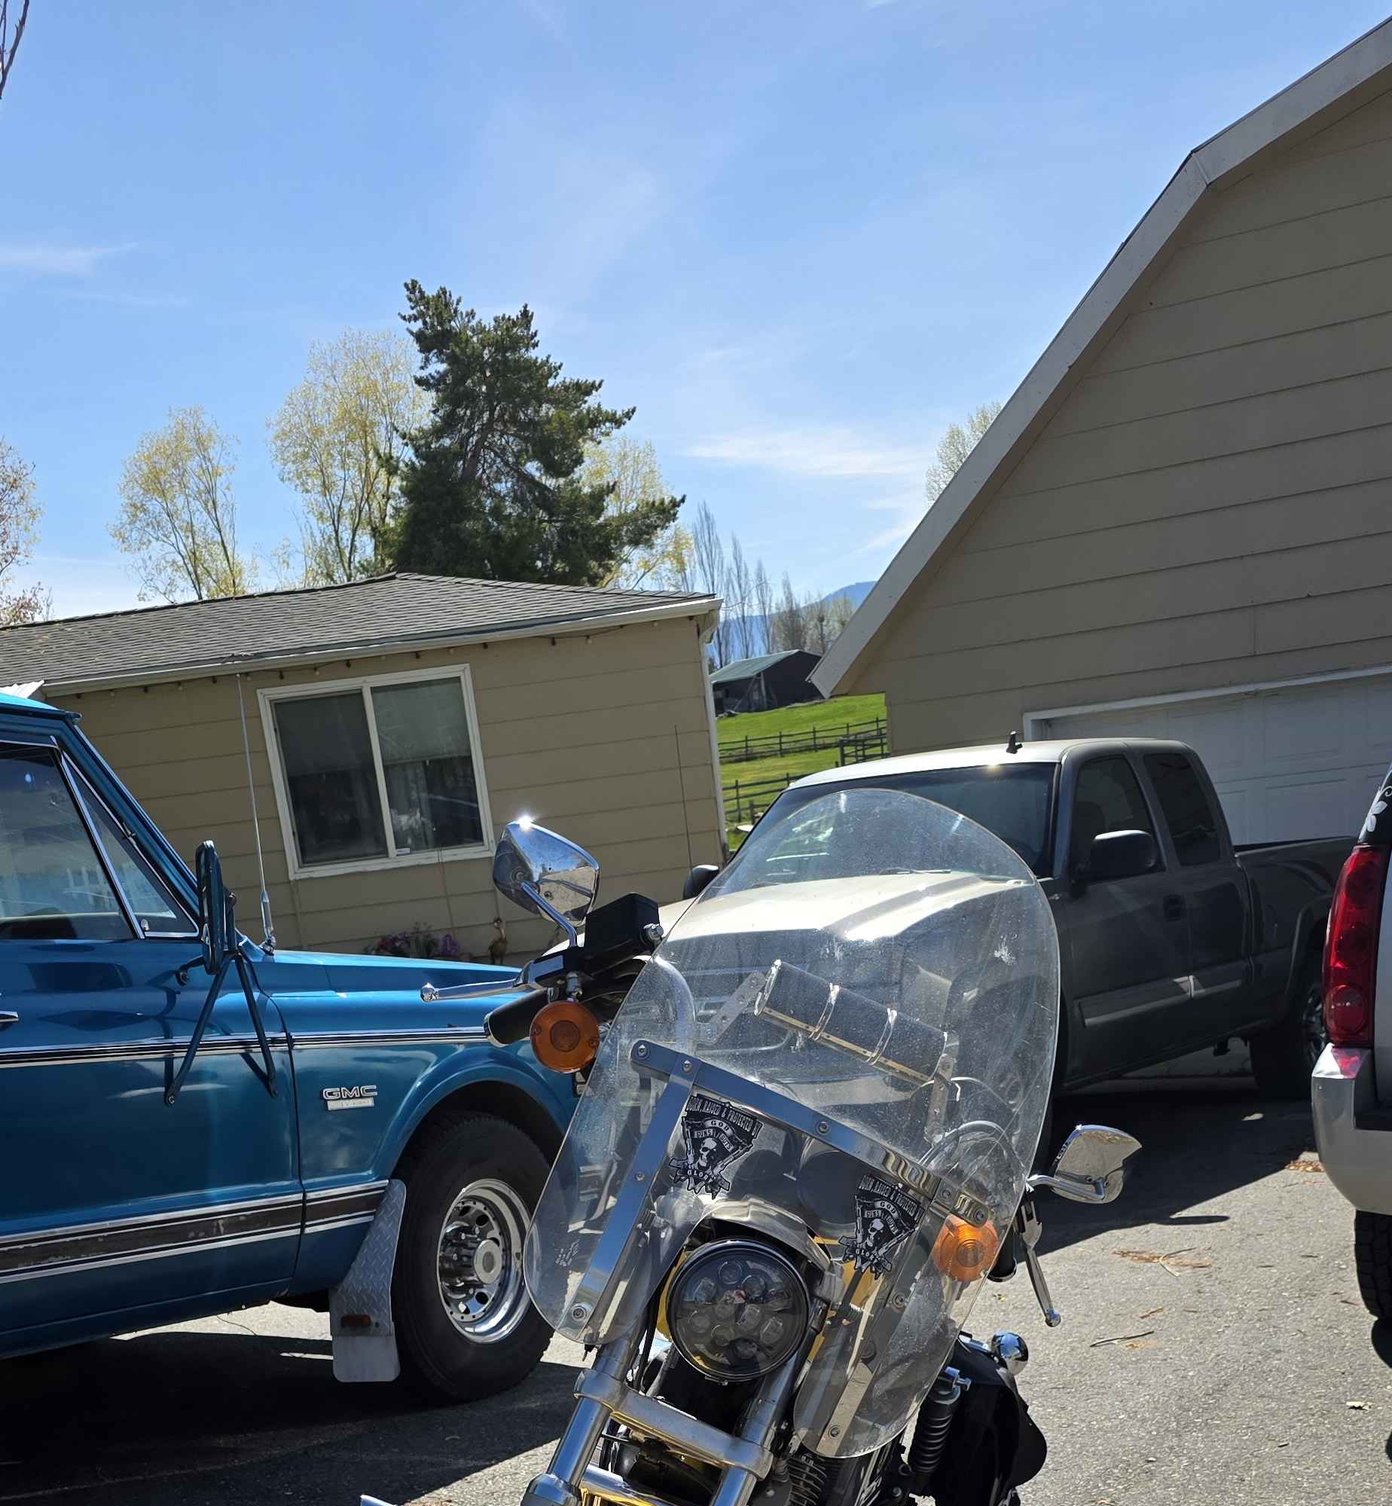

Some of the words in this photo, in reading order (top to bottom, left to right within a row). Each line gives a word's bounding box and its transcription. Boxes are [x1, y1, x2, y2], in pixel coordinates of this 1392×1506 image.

[322, 1085, 378, 1100] GMC
[711, 1120, 729, 1131] GOD
[727, 1110, 753, 1132] PROTECTED
[880, 1201, 896, 1214] GOD
